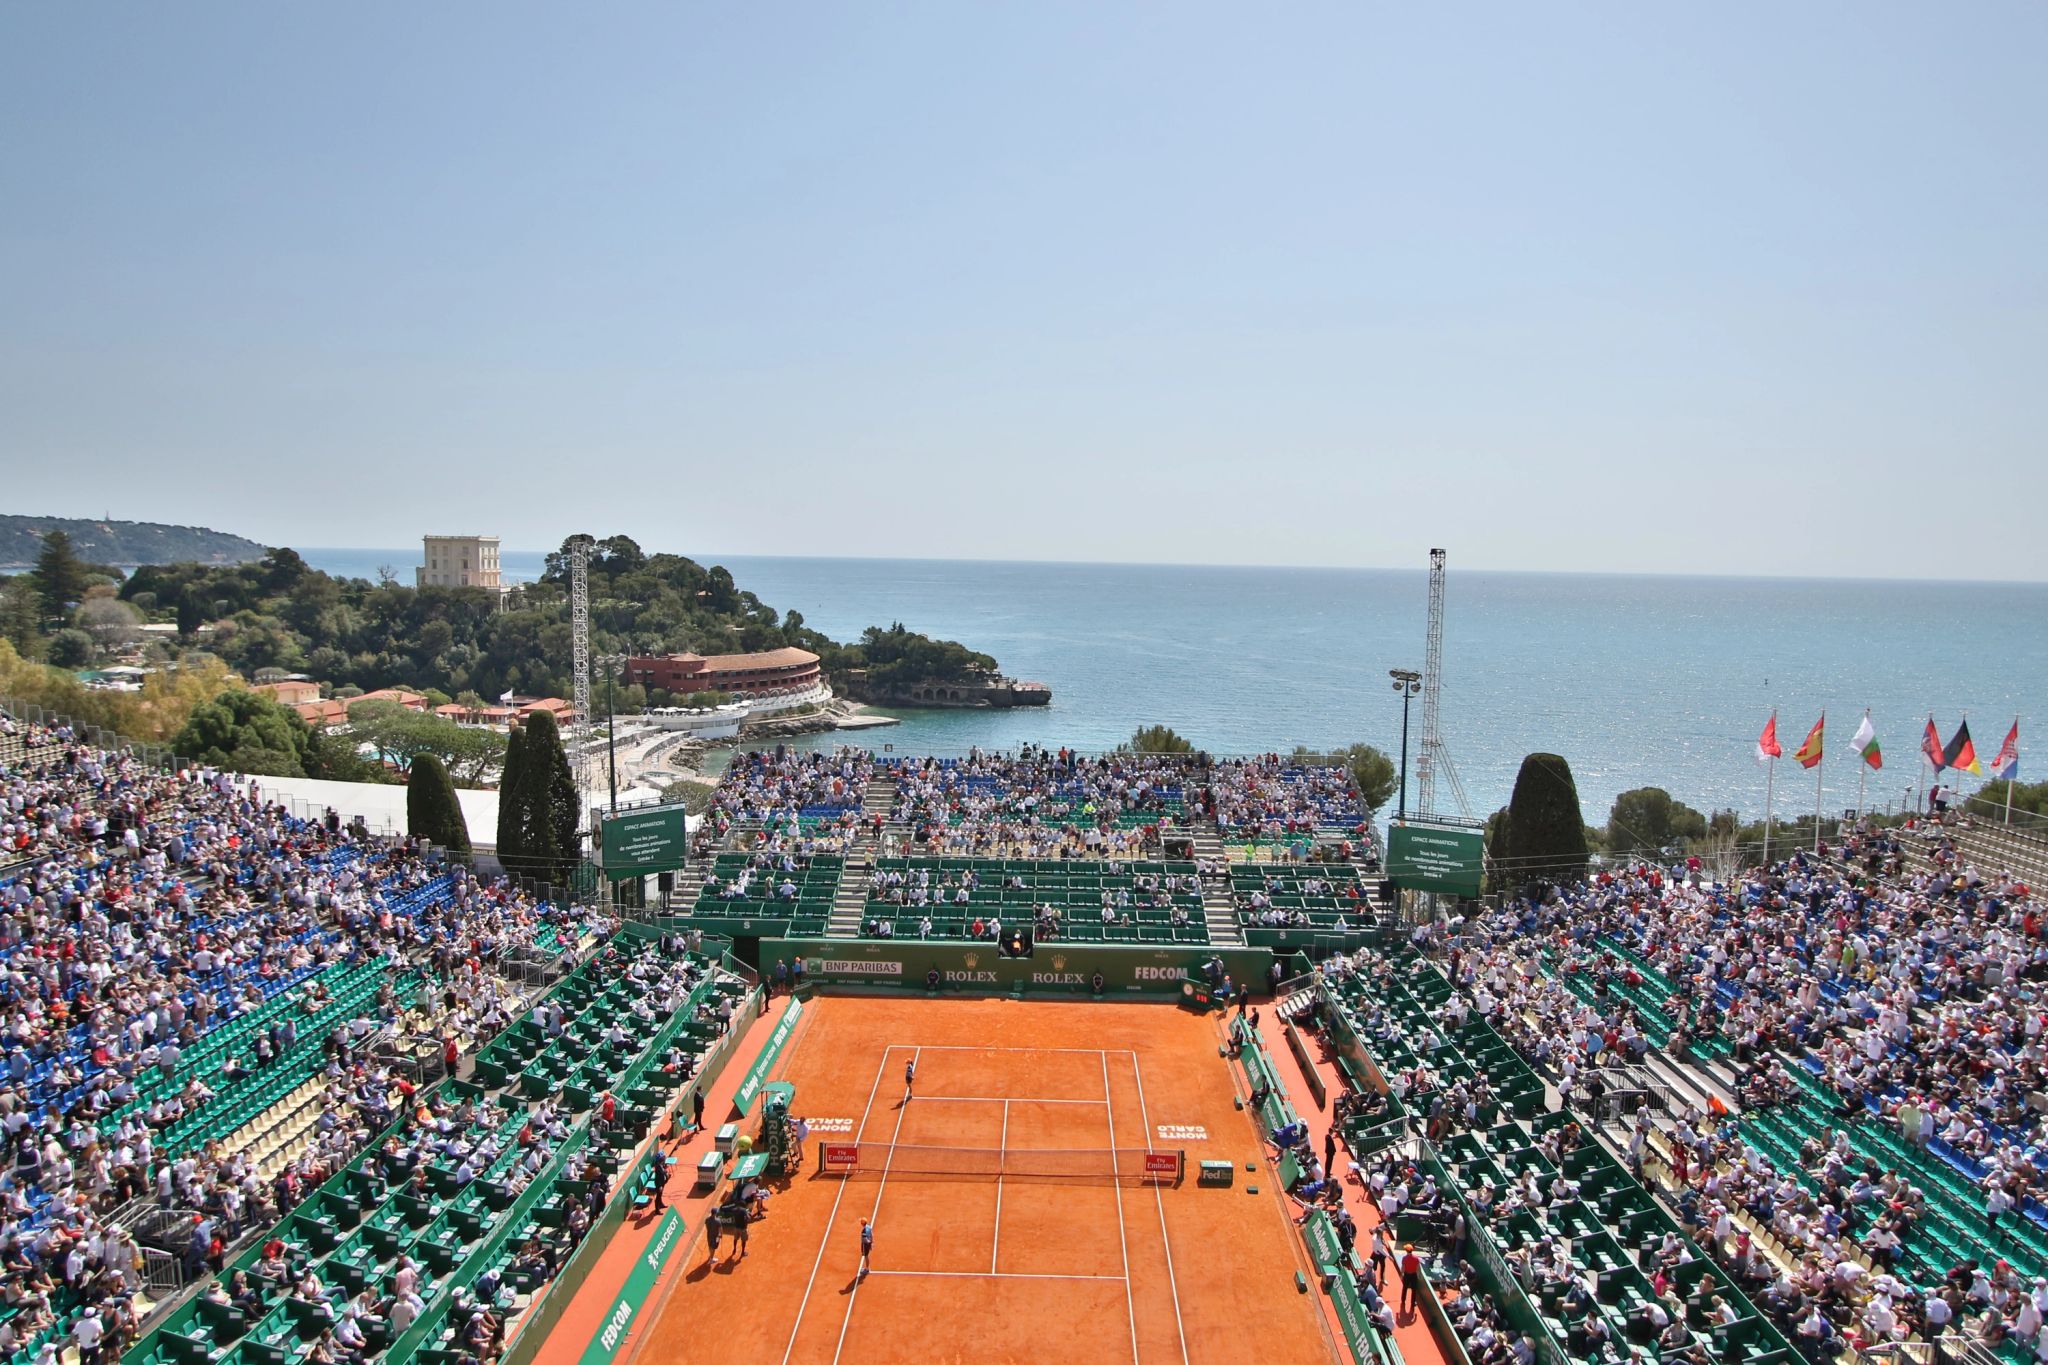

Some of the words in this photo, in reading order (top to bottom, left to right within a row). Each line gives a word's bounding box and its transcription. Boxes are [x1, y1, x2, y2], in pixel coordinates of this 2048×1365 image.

[624, 823, 640, 831] ESPACE
[640, 820, 666, 828] ANIMATIONS
[650, 839, 671, 847] animations
[1428, 838, 1459, 846] ANIMATIONS
[641, 847, 660, 855] attendent
[826, 961, 848, 971] BNP
[851, 962, 897, 972] PARIBAS
[946, 971, 997, 982] ROLEX
[1033, 973, 1085, 983] ROLEX
[1135, 966, 1188, 980] FEDCOM
[769, 1120, 779, 1166] RICOH
[654, 1215, 679, 1260] PEUGEOT
[1312, 1218, 1331, 1262] Malongo
[601, 1300, 632, 1352] FEDCOM
